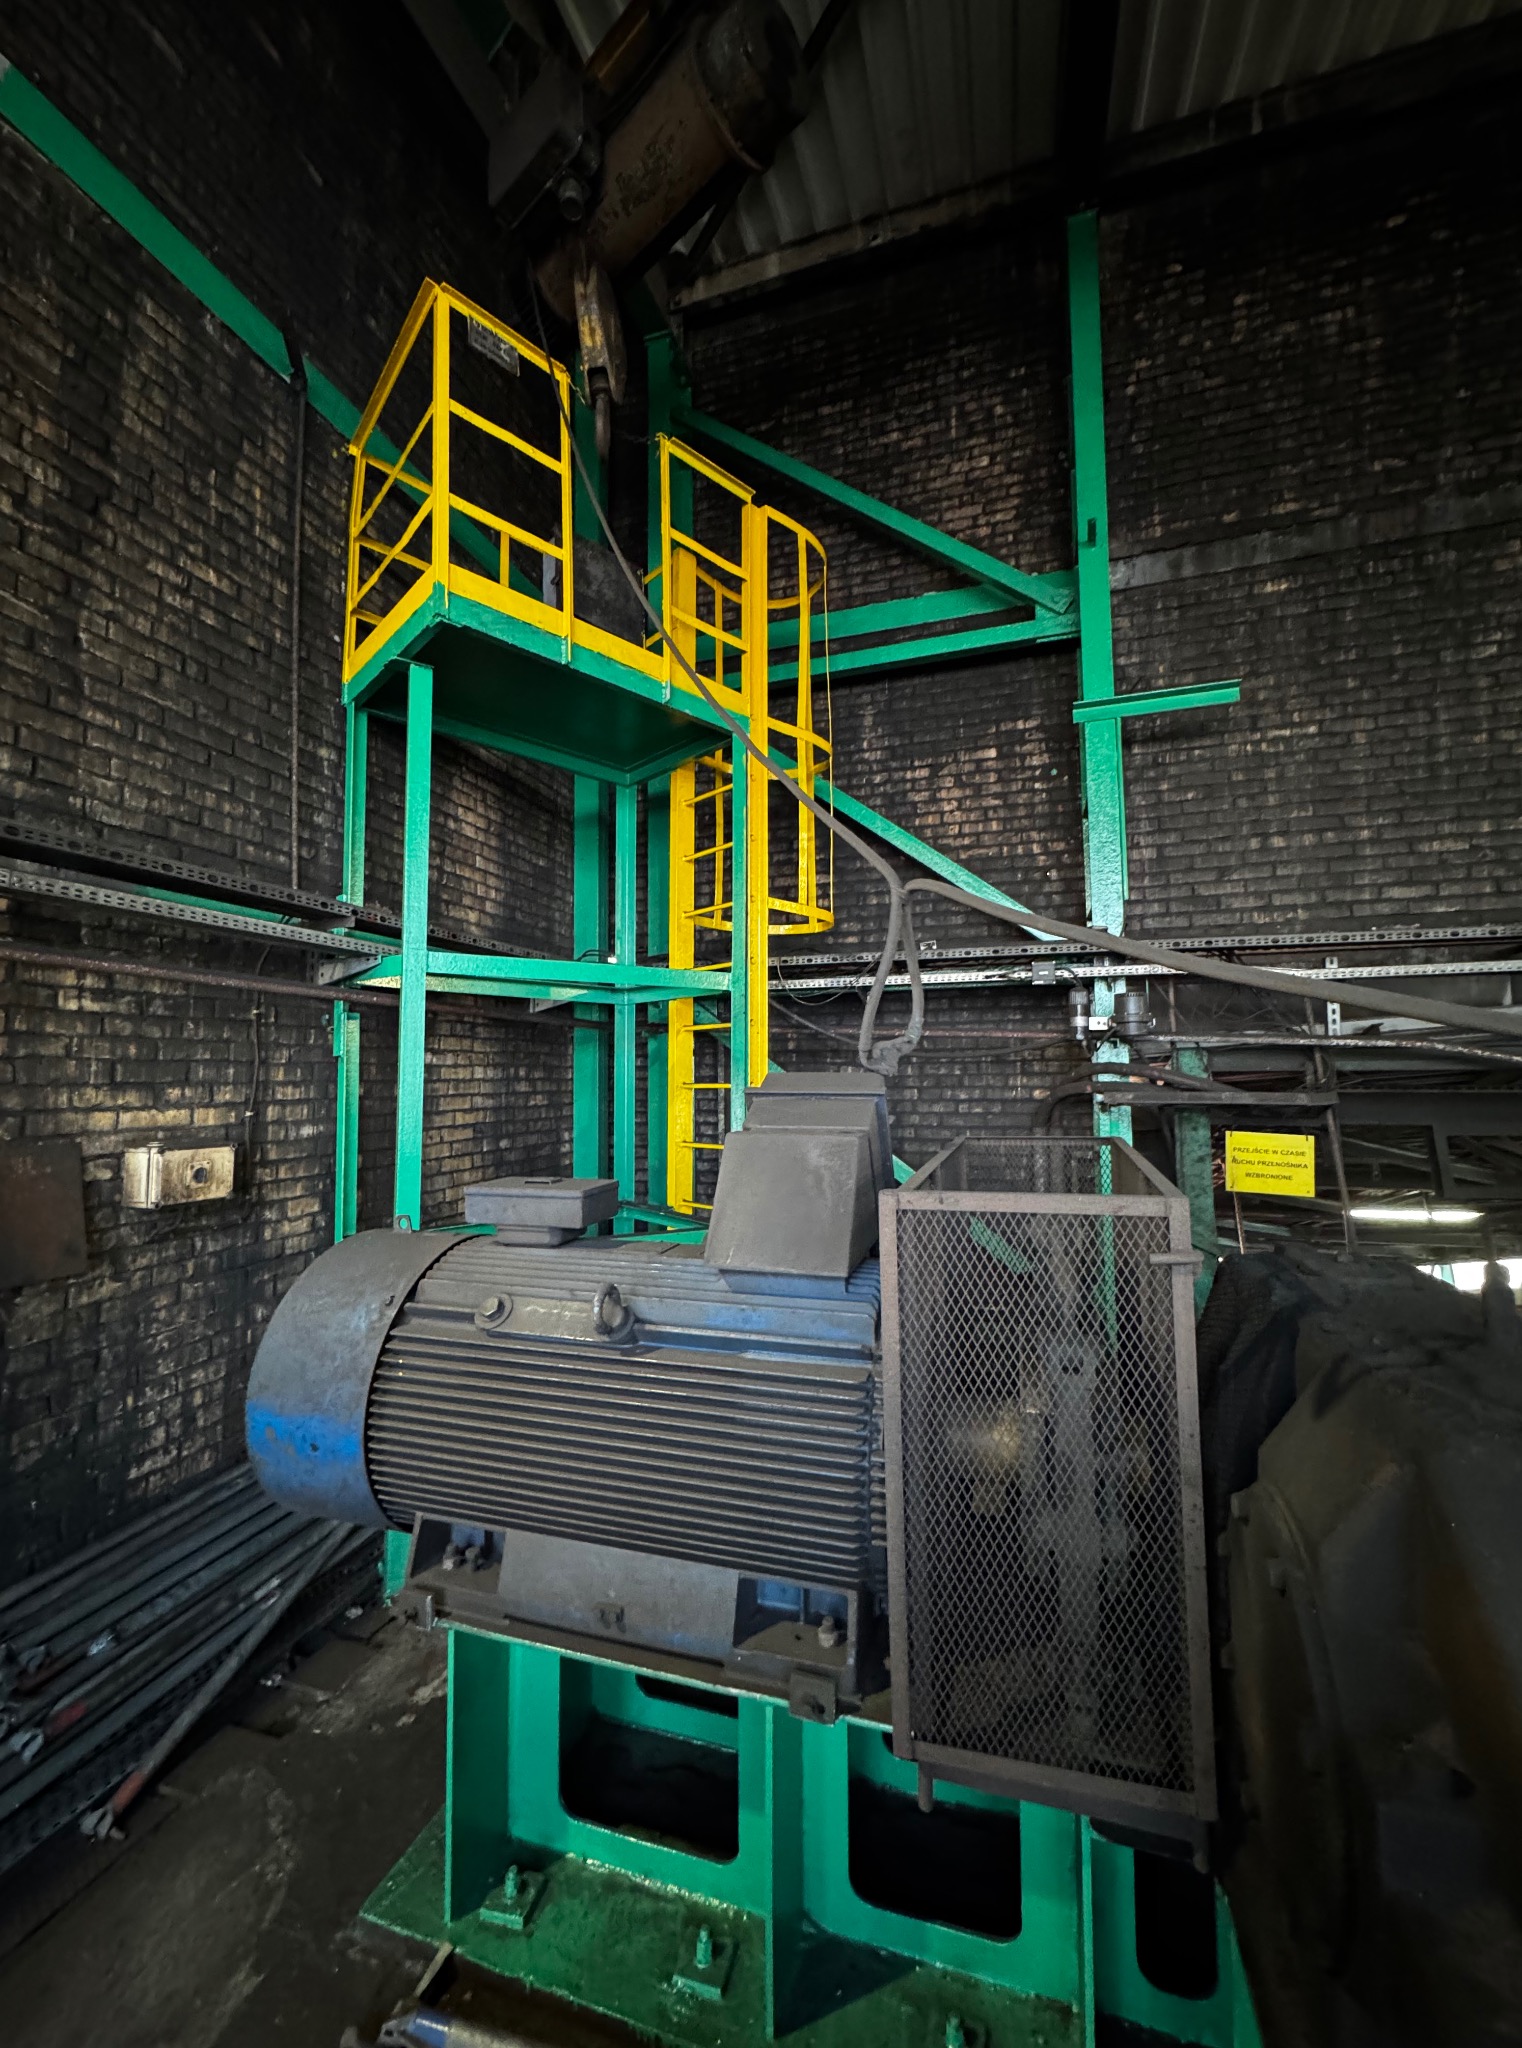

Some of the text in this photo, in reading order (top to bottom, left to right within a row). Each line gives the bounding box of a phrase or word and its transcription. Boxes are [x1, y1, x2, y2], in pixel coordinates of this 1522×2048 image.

[1233, 1146, 1269, 1154] PRZEJŚCIE
[1280, 1149, 1307, 1157] CZASIE
[1257, 1160, 1308, 1169] PRZENOŚNIKA
[1245, 1172, 1293, 1181] WZBRONIONE
